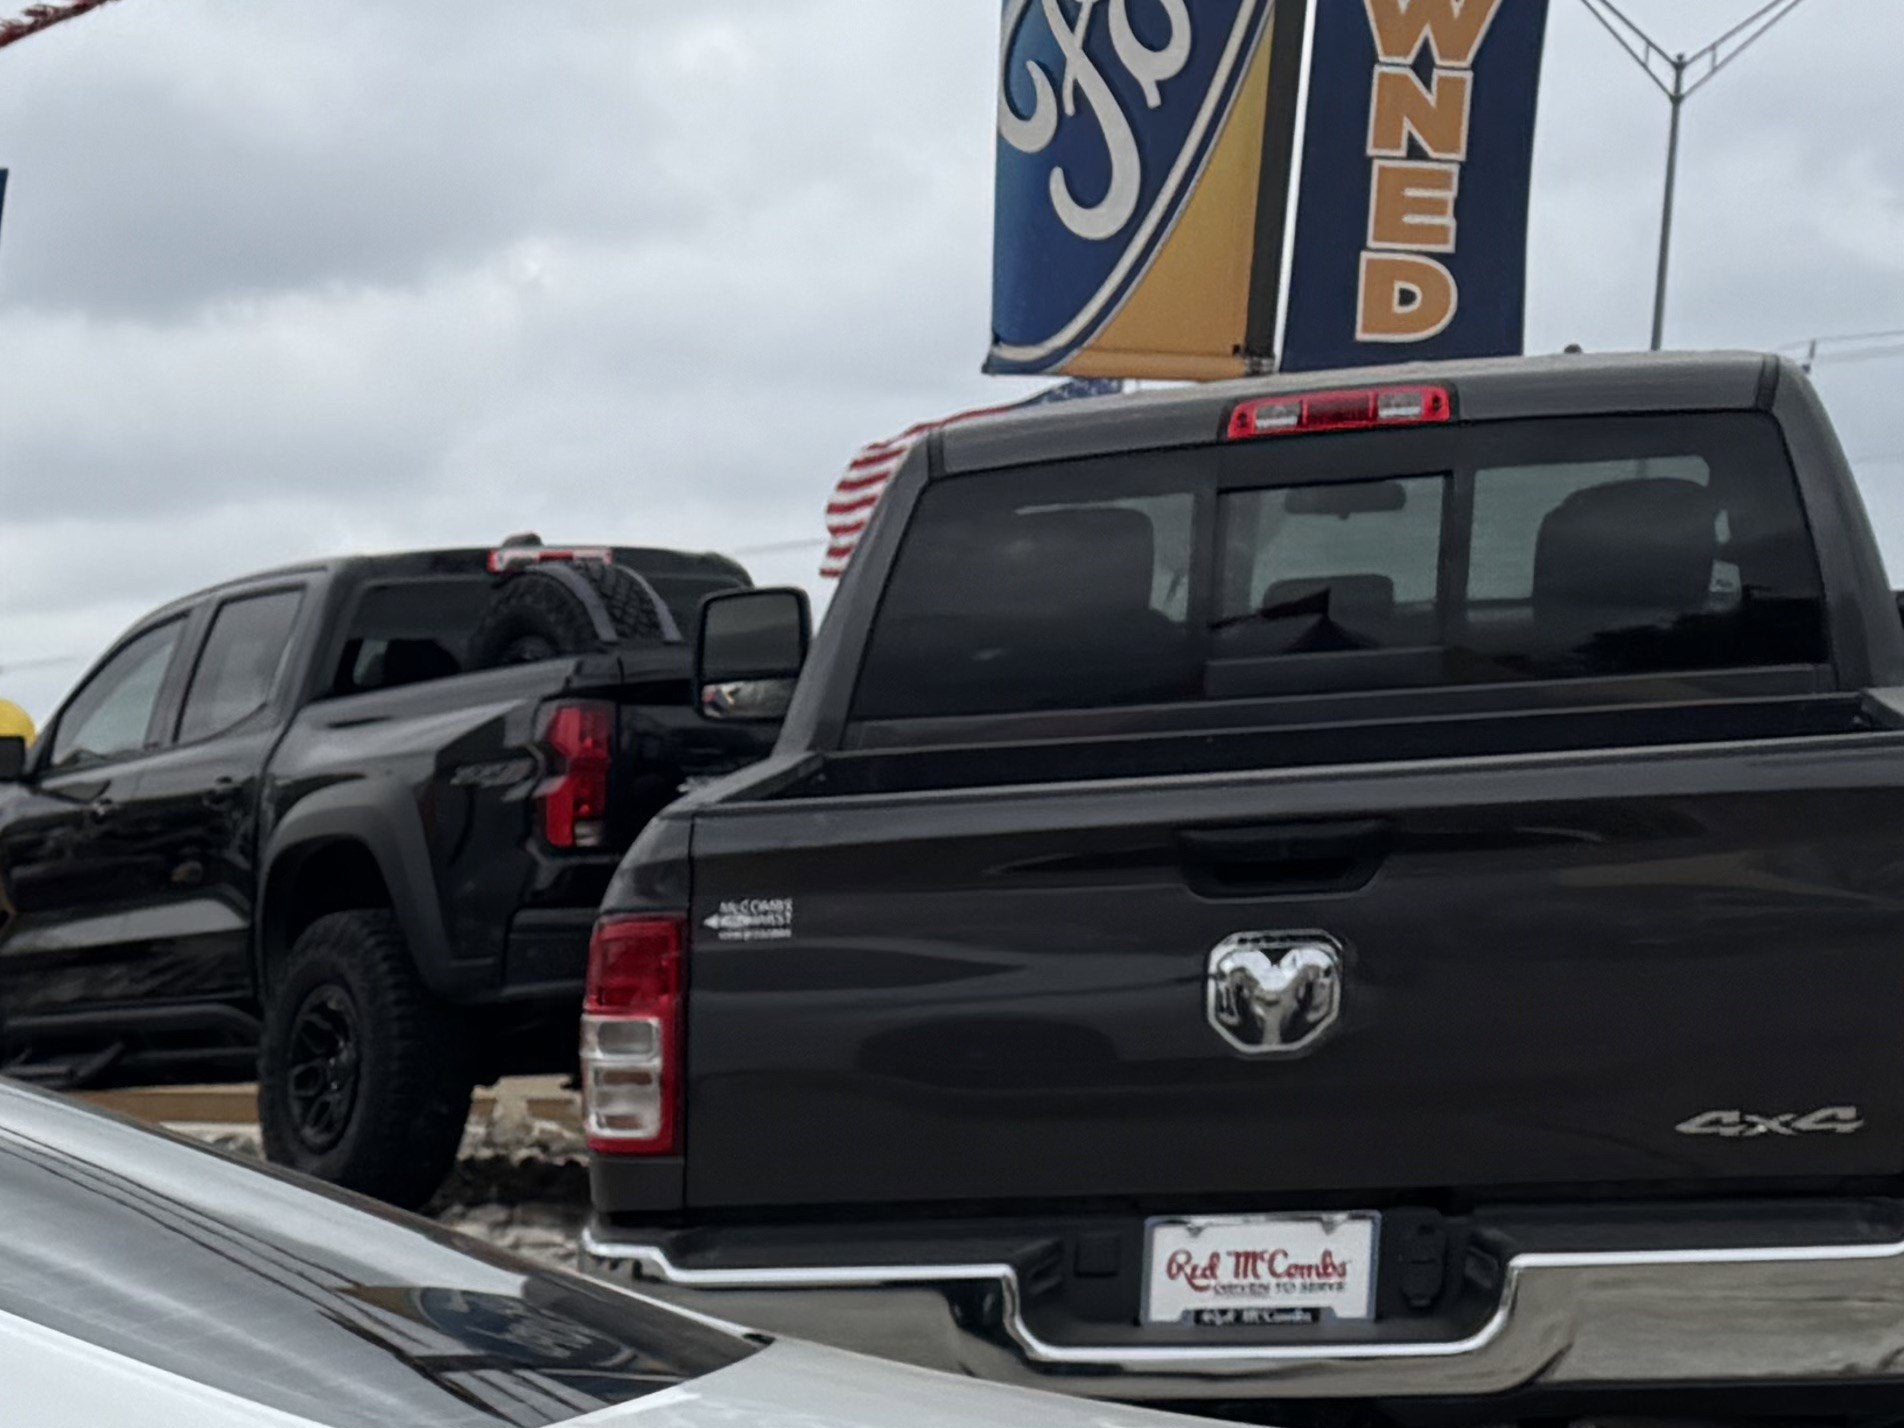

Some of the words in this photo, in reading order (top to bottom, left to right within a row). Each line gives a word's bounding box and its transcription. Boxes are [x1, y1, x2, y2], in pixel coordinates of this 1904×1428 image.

[1166, 1249, 1221, 1292] Red
[1226, 1248, 1348, 1281] McCombs
[1275, 1281, 1297, 1294] TO
